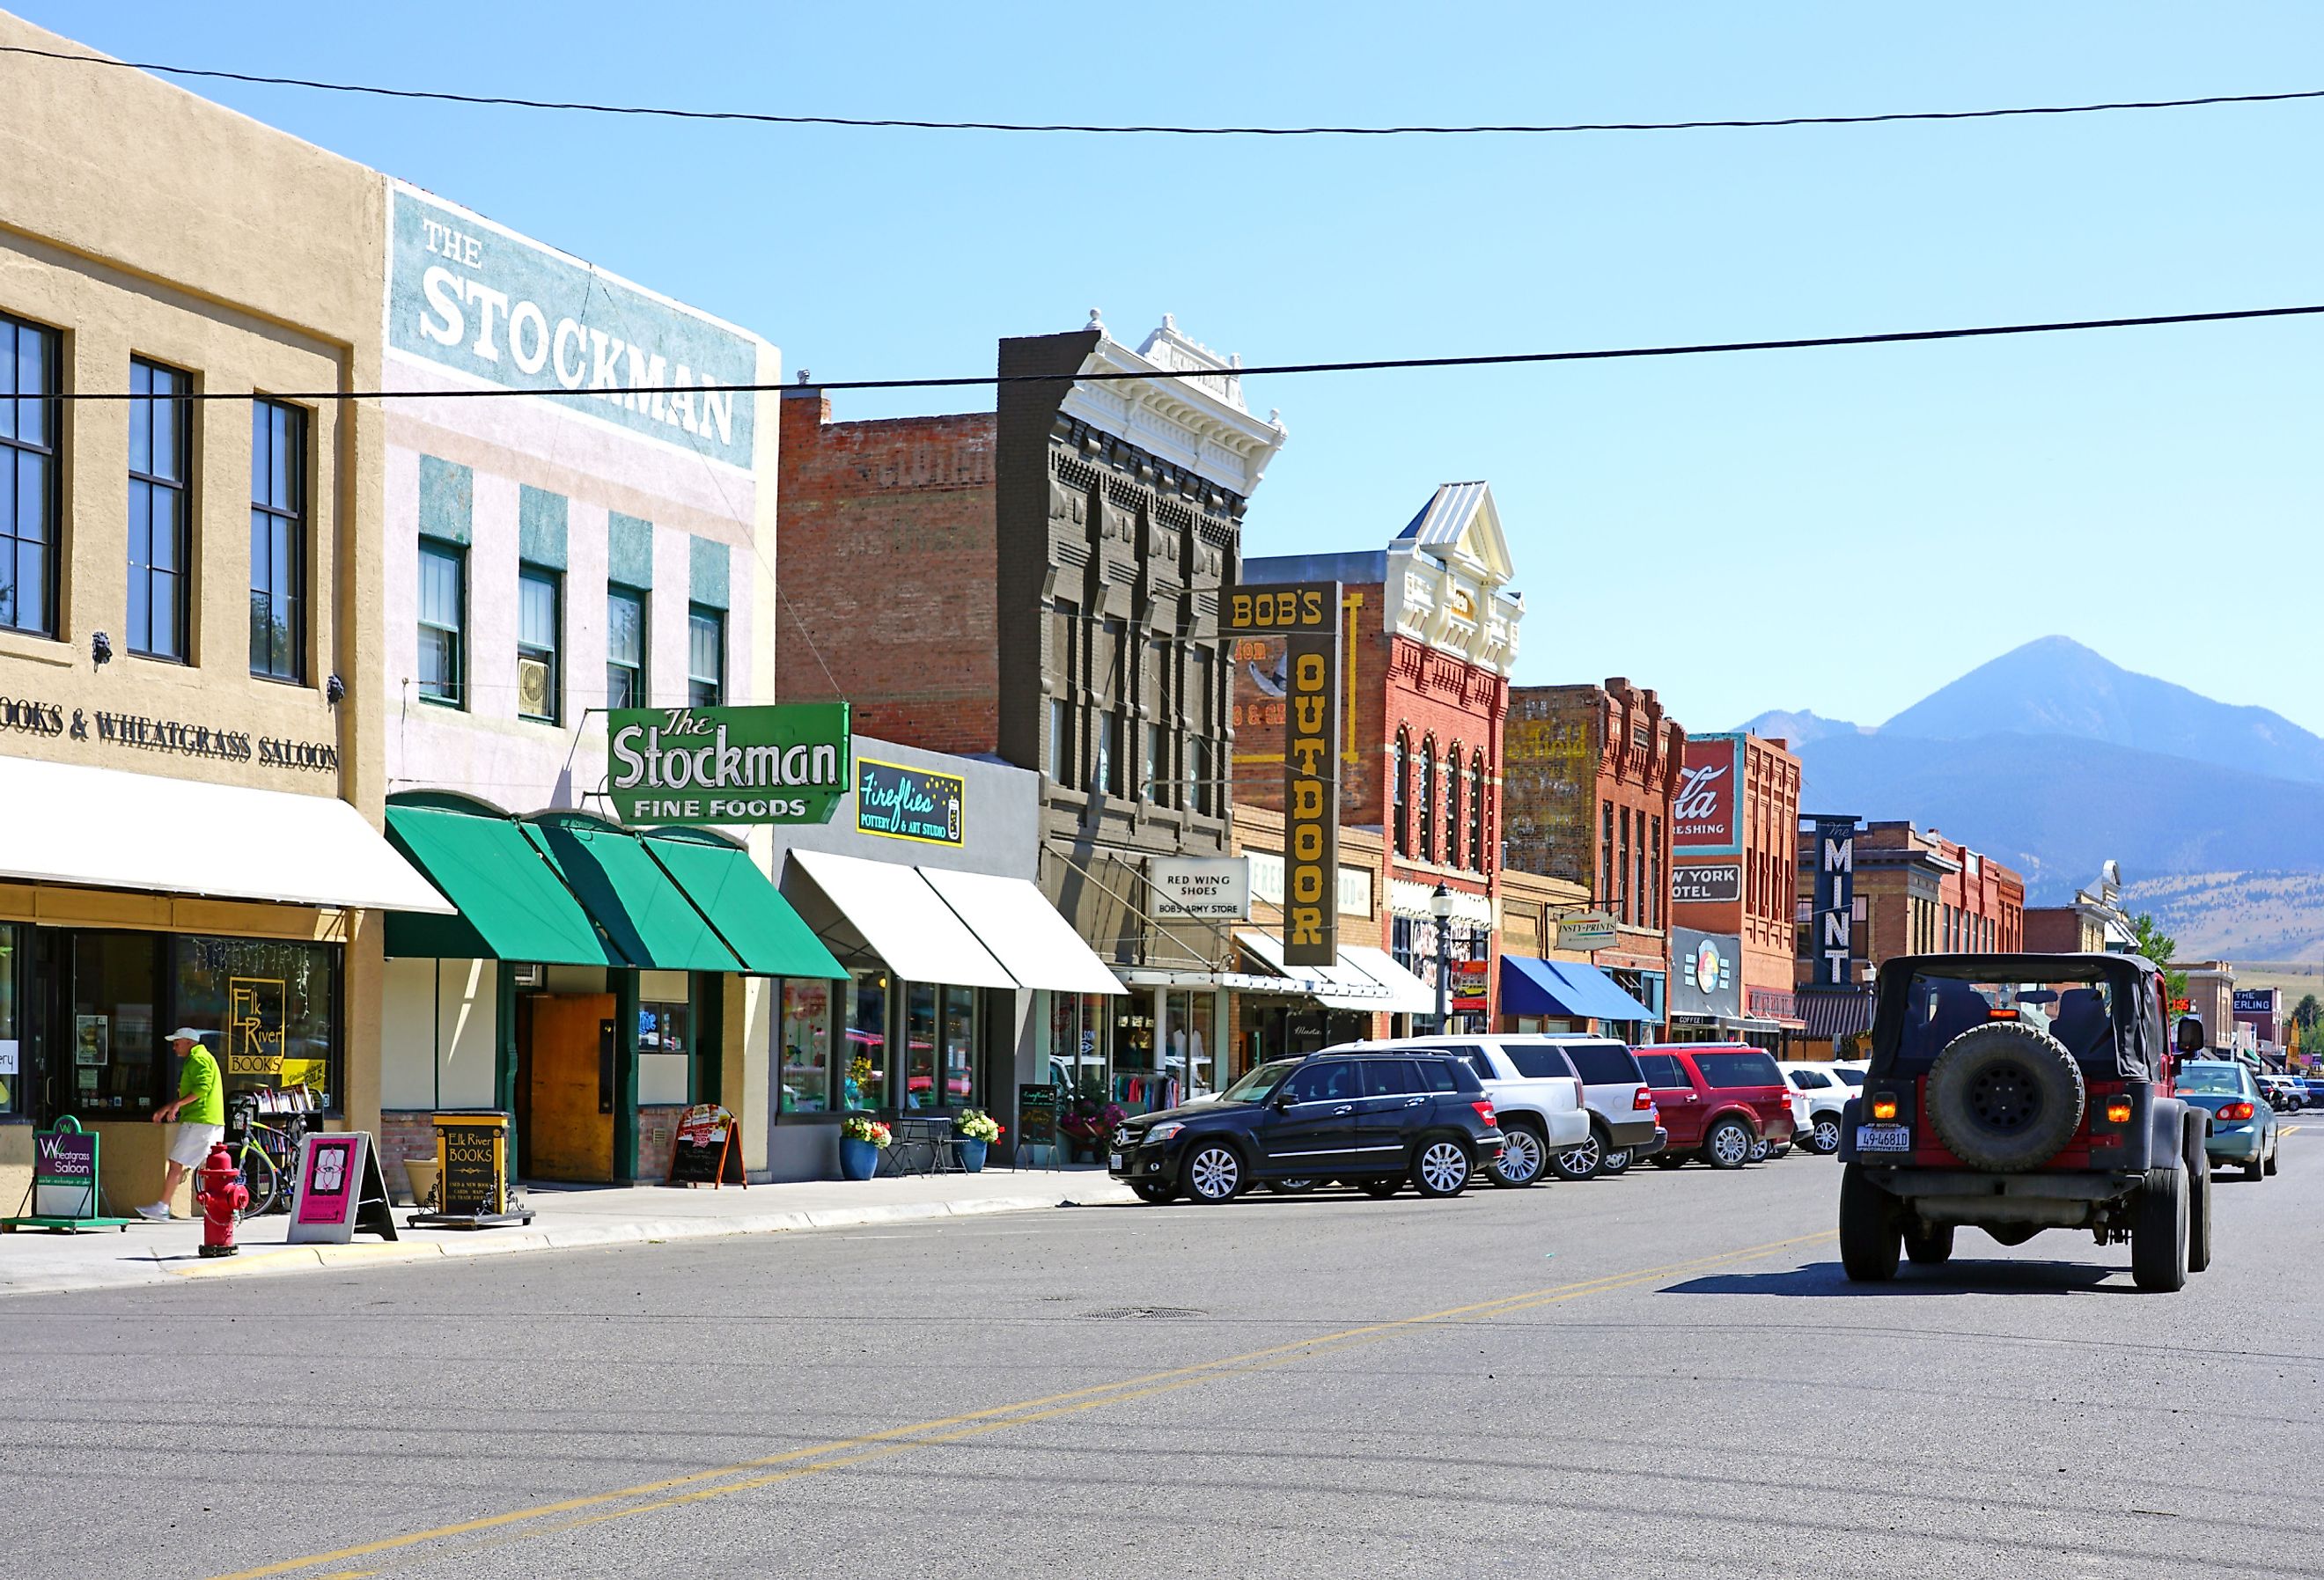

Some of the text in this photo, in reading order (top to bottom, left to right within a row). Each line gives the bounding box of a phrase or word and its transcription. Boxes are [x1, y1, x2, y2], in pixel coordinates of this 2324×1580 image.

[422, 217, 482, 270] THE
[419, 264, 734, 446] STOCKMAN
[1232, 589, 1322, 628] BOB'S
[660, 709, 714, 737] The
[70, 708, 89, 740] &
[94, 710, 252, 761] WHEATGRASS
[258, 736, 339, 770] SALOON
[612, 724, 839, 790] Stockman
[634, 798, 807, 818] FINE FOODS
[859, 772, 934, 833] Fireflies
[1291, 654, 1326, 944] OUTDOOR
[861, 812, 946, 839] POTTERY & ART STUDIO
[1827, 821, 1850, 837] The
[1167, 875, 1231, 885] RED WING
[1689, 870, 1735, 883] YORK
[1181, 886, 1217, 895] SHOES
[1673, 886, 1711, 898] OTEL
[1212, 905, 1238, 914] STORE
[1825, 838, 1853, 983] MINT
[1559, 923, 1615, 933] INSTY-PRINTS
[232, 988, 262, 1026] Elk
[2233, 1001, 2270, 1010] ERLING
[245, 1017, 282, 1054] River
[232, 1057, 281, 1072] BOOKS
[40, 1135, 90, 1163] Wheatgrass
[448, 1133, 491, 1146] Elk River
[55, 1160, 89, 1173] Saloon
[449, 1149, 492, 1162] BOOKS
